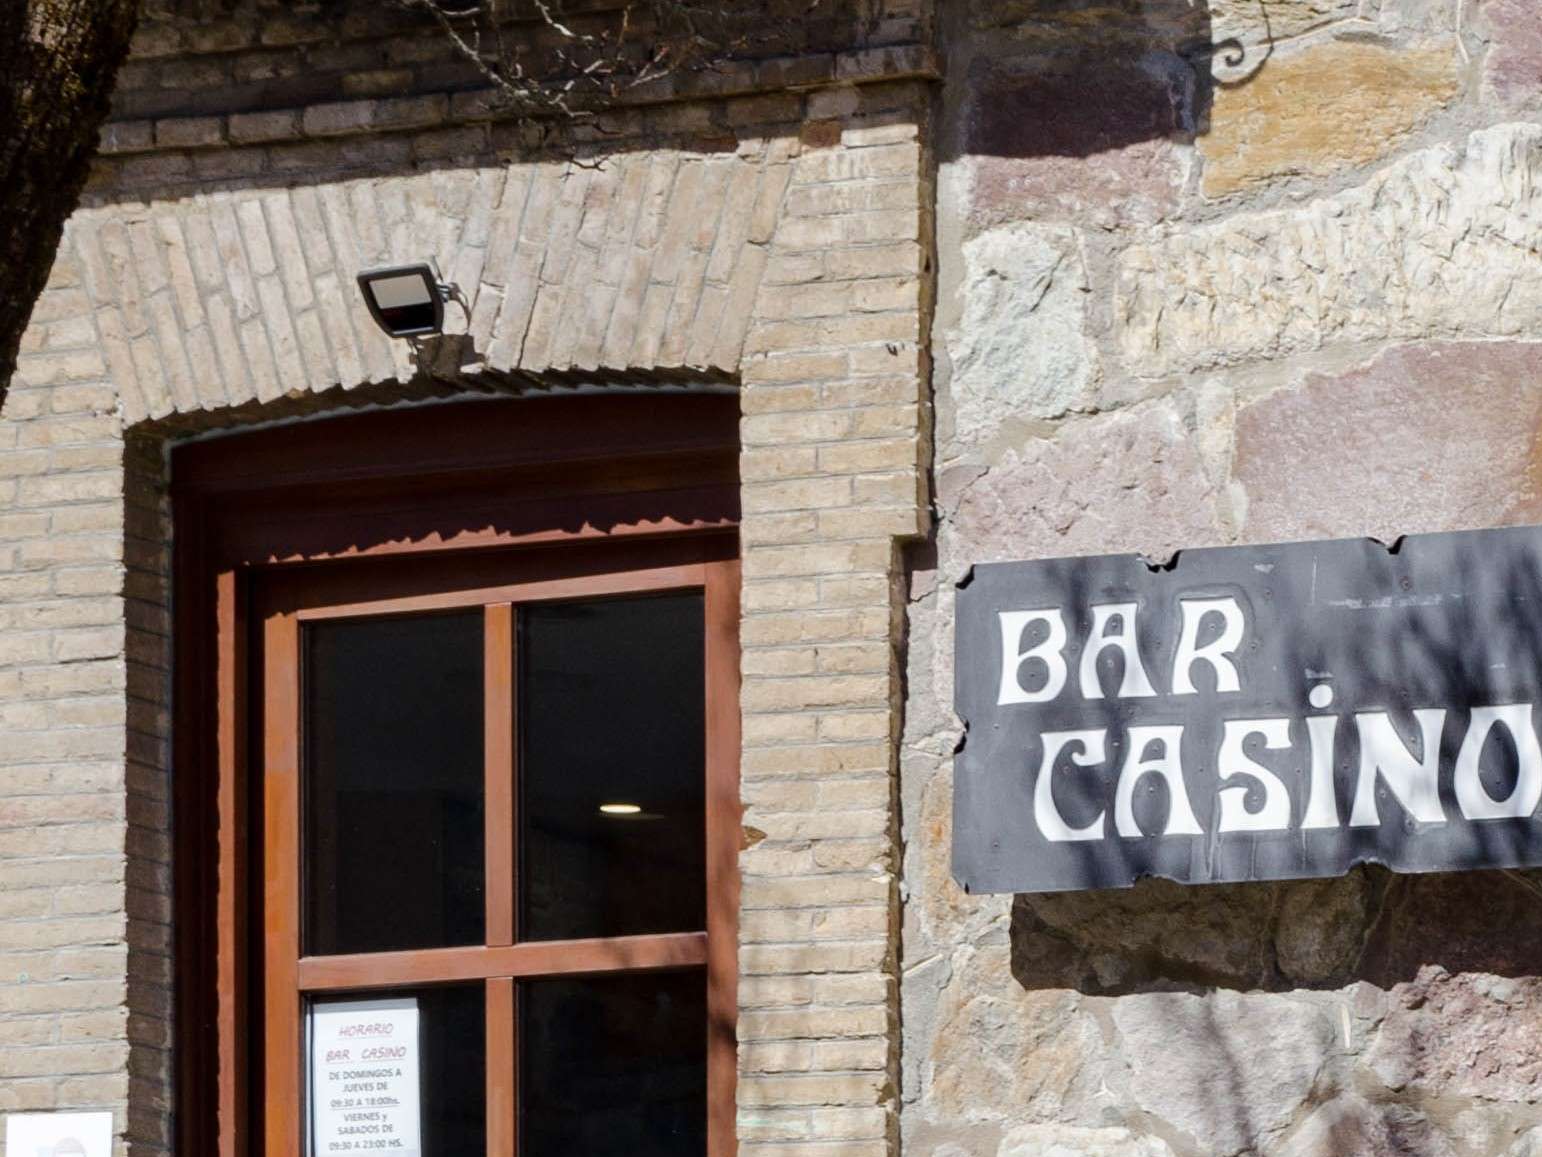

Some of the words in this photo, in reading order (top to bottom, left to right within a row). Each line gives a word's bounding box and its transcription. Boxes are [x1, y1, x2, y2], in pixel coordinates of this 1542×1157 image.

[997, 597, 1245, 705] BAR
[339, 1023, 394, 1036] HORARIO
[326, 1049, 350, 1062] BAR
[361, 1046, 407, 1059] CASINO
[343, 1112, 380, 1121] VIERNES
